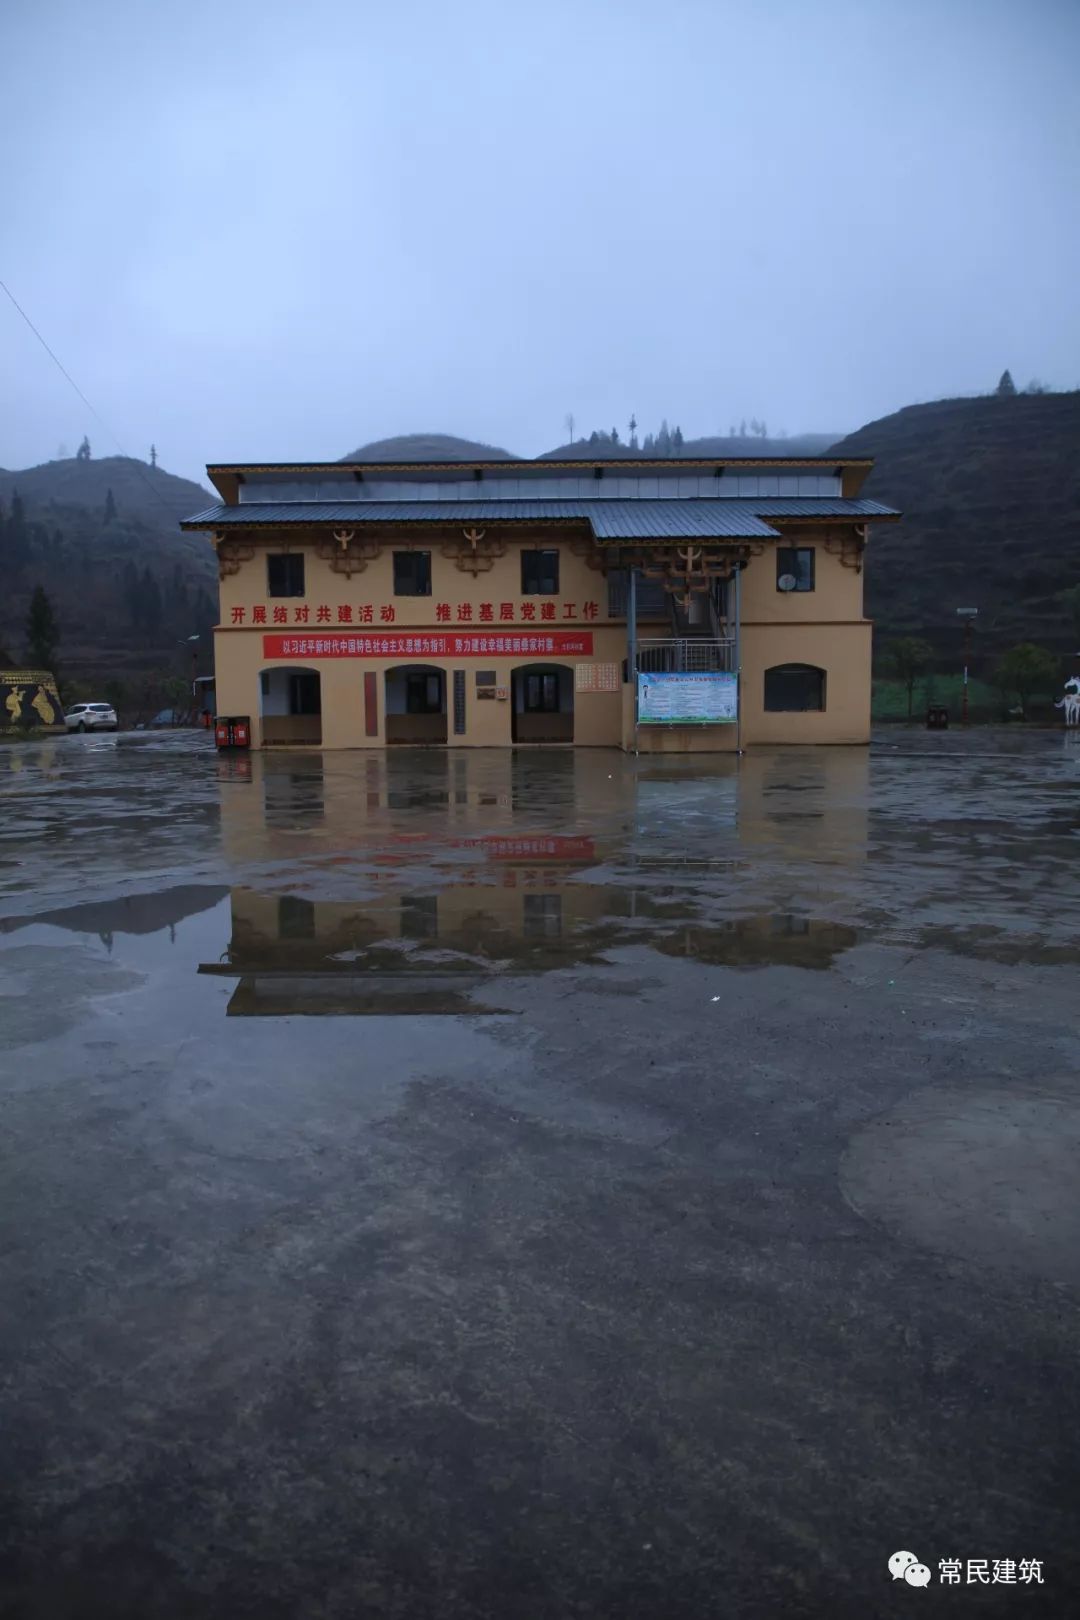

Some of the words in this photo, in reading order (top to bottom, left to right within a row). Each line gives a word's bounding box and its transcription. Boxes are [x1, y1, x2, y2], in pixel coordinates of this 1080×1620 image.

[231, 605, 394, 624] 开展结对共建活动
[435, 602, 598, 622] 推进基层党建工作
